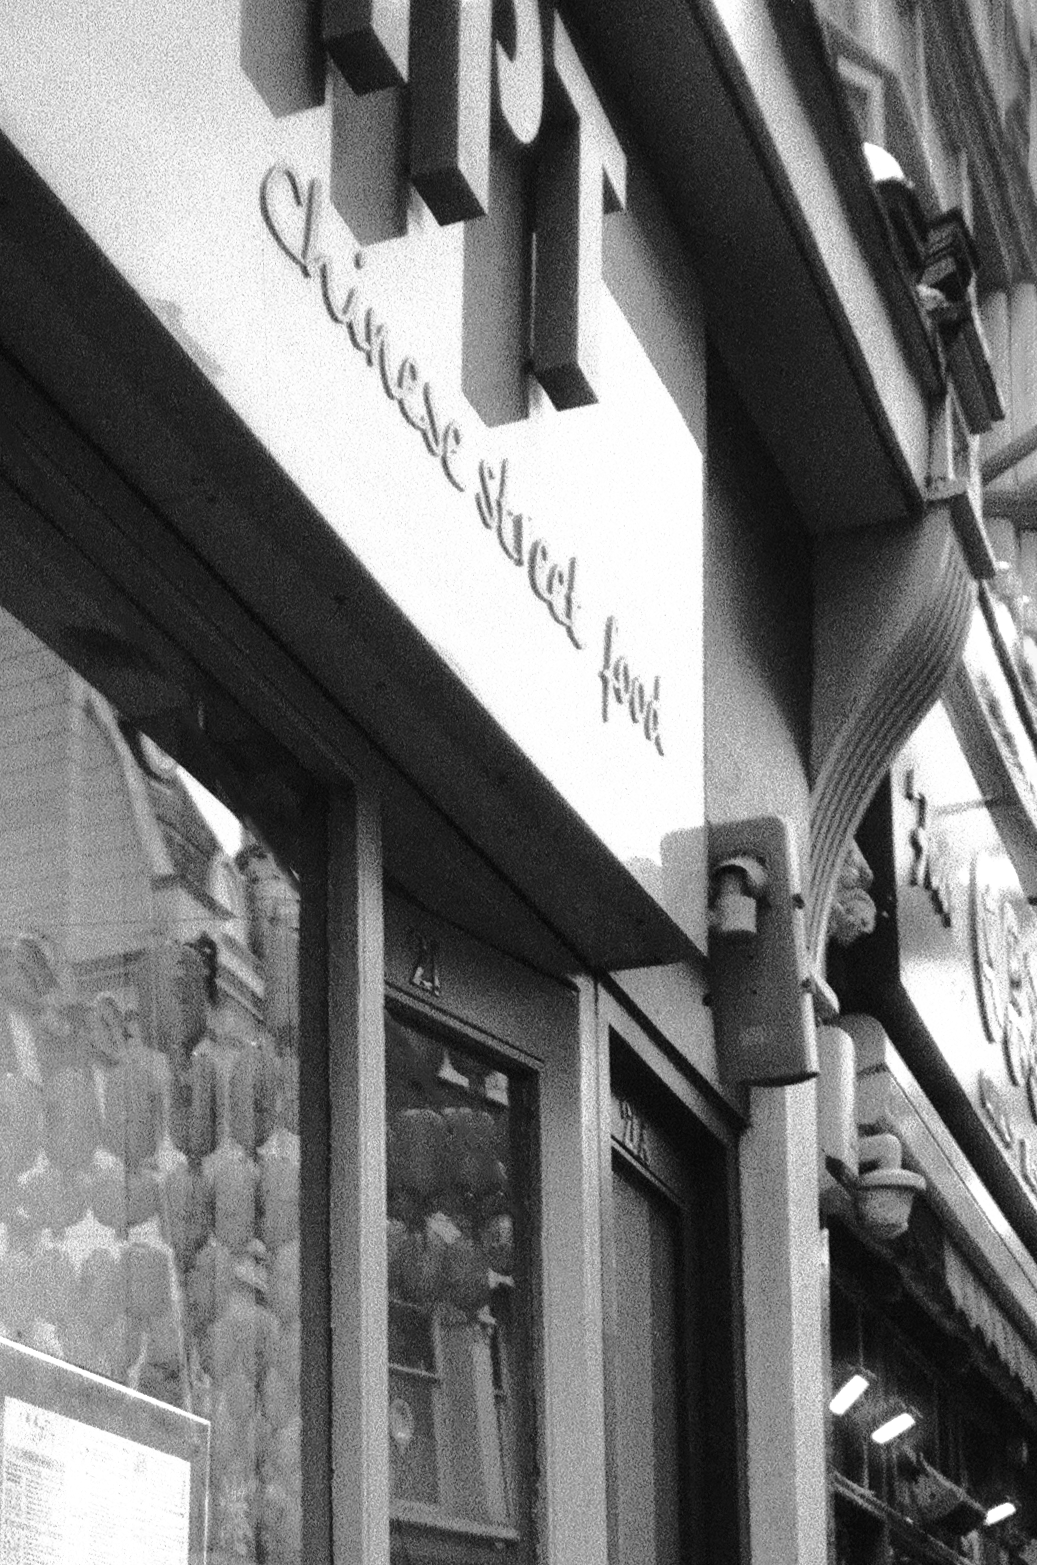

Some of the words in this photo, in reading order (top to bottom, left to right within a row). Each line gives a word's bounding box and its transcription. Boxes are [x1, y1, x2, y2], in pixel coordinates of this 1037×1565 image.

[259, 162, 464, 492] Chinese
[474, 457, 584, 650] street
[598, 615, 665, 757] food
